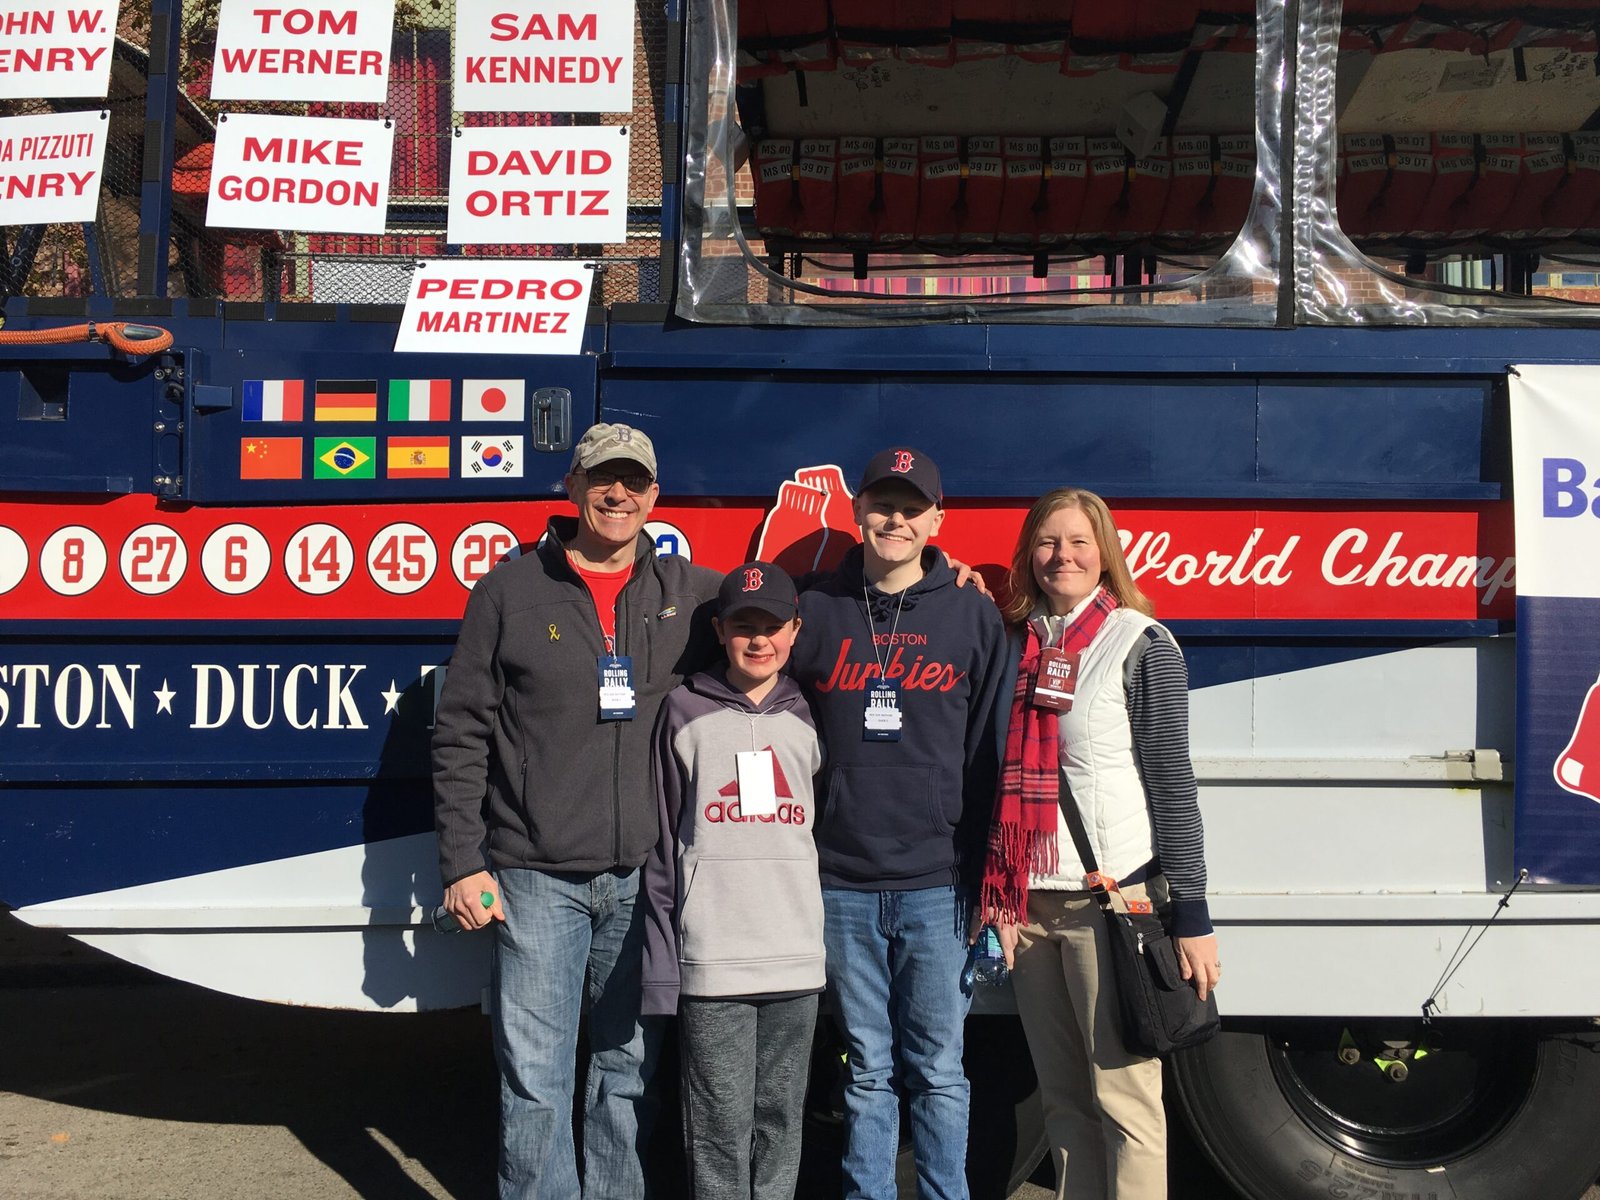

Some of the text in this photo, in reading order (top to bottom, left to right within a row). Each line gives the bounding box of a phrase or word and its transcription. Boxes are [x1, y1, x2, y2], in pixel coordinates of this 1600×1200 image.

[0, 10, 107, 35] HN W.
[253, 9, 357, 35] TOM
[490, 14, 597, 41] SAM
[221, 48, 382, 76] WERNER
[465, 56, 623, 84] KENNEDY
[19, 133, 94, 161] PIZZUTI
[243, 137, 363, 166] MIKE
[467, 150, 611, 176] DAVID
[0, 171, 96, 199] NRY
[217, 175, 379, 207] GORDON
[465, 190, 610, 217] ORTIZ
[416, 279, 583, 300] PEDRO
[416, 311, 570, 334] MARTINEZ
[890, 450, 915, 473] B
[1542, 457, 1600, 520] B
[62, 538, 85, 583] 8
[131, 536, 177, 582] 27
[224, 536, 248, 582] 6
[298, 536, 340, 582] 14
[372, 535, 426, 581] 45
[1116, 527, 1516, 606] World Champ
[742, 567, 764, 592] B
[872, 634, 927, 645] BOSTON
[604, 678, 628, 687] RALLY
[1047, 667, 1070, 678] RALLY
[190, 664, 369, 729] DUCK
[870, 699, 896, 708] RALLY
[704, 801, 805, 825] adas
